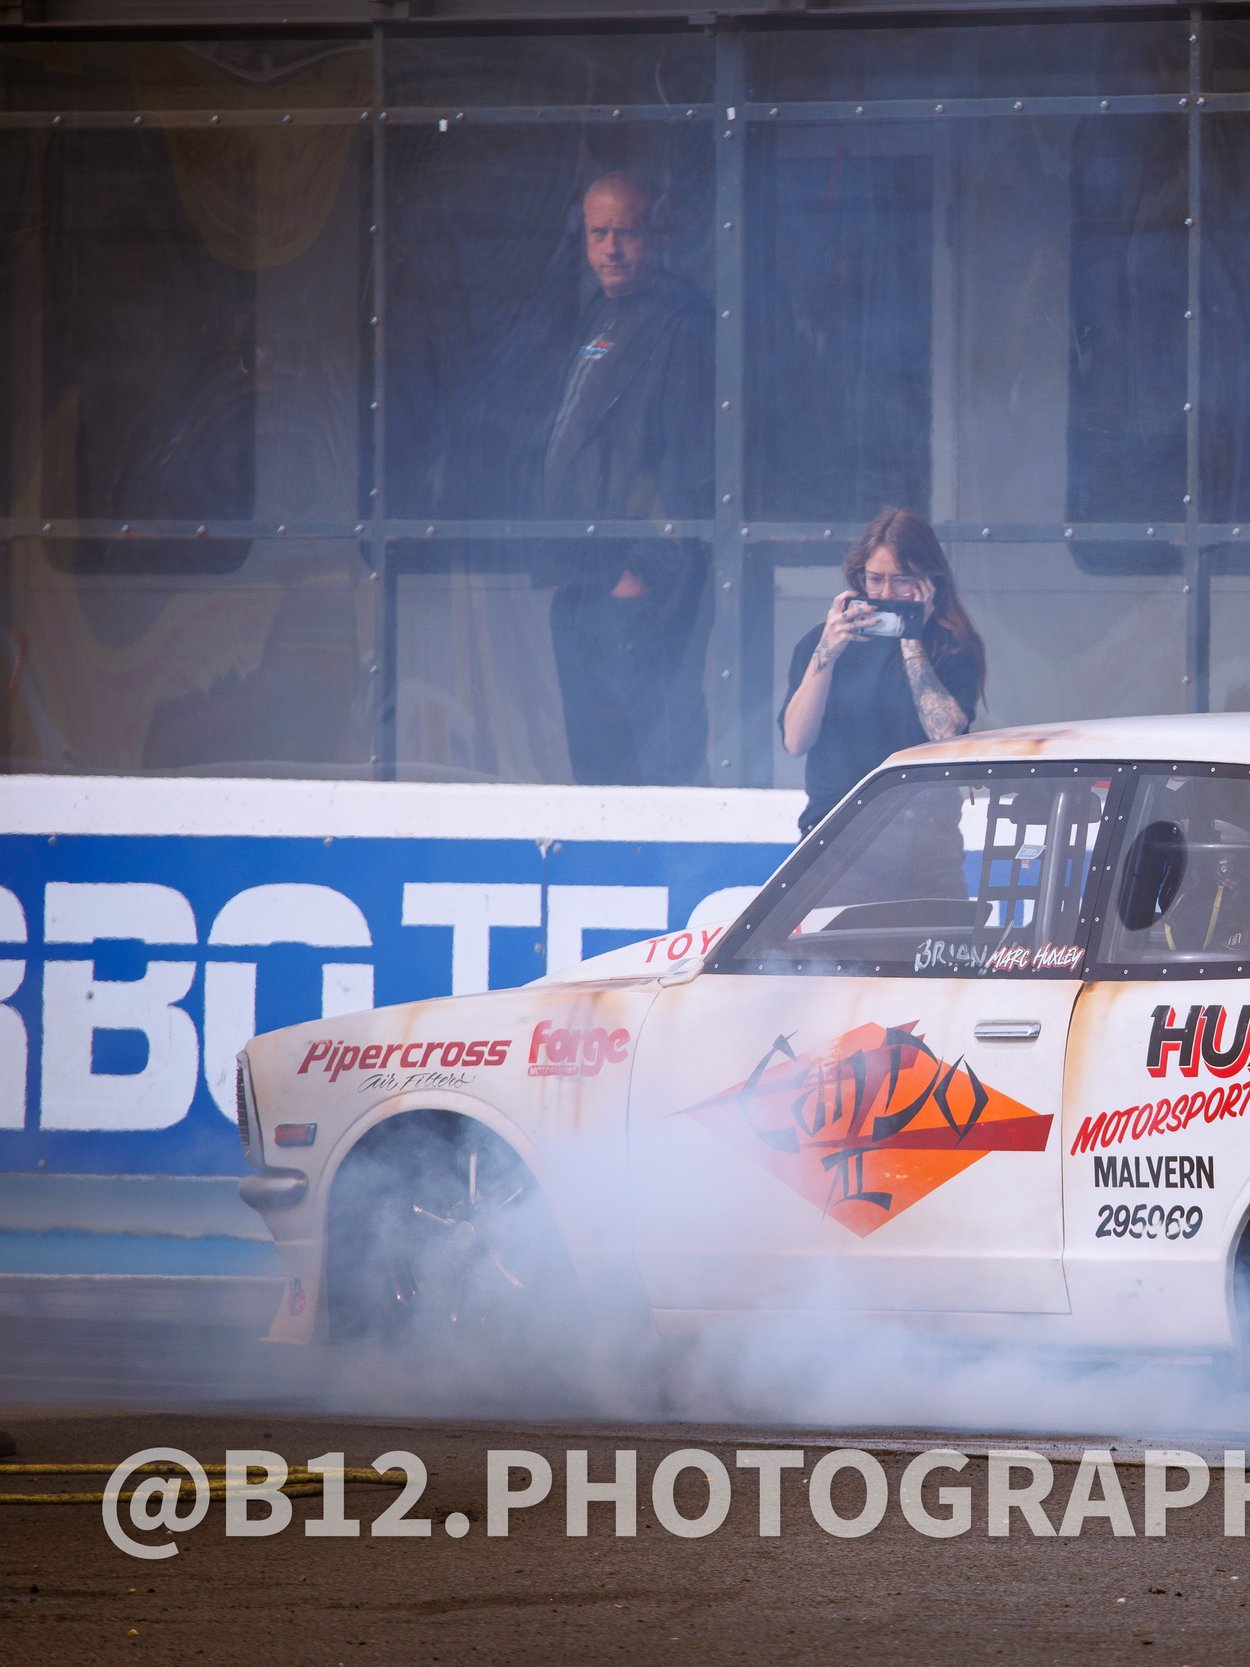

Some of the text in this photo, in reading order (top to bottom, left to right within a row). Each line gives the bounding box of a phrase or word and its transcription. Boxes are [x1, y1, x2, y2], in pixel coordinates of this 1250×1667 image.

[985, 943, 1086, 972] MARC HUXLEY
[296, 1038, 513, 1083] Pipercross
[1093, 1155, 1215, 1188] MALVERN
